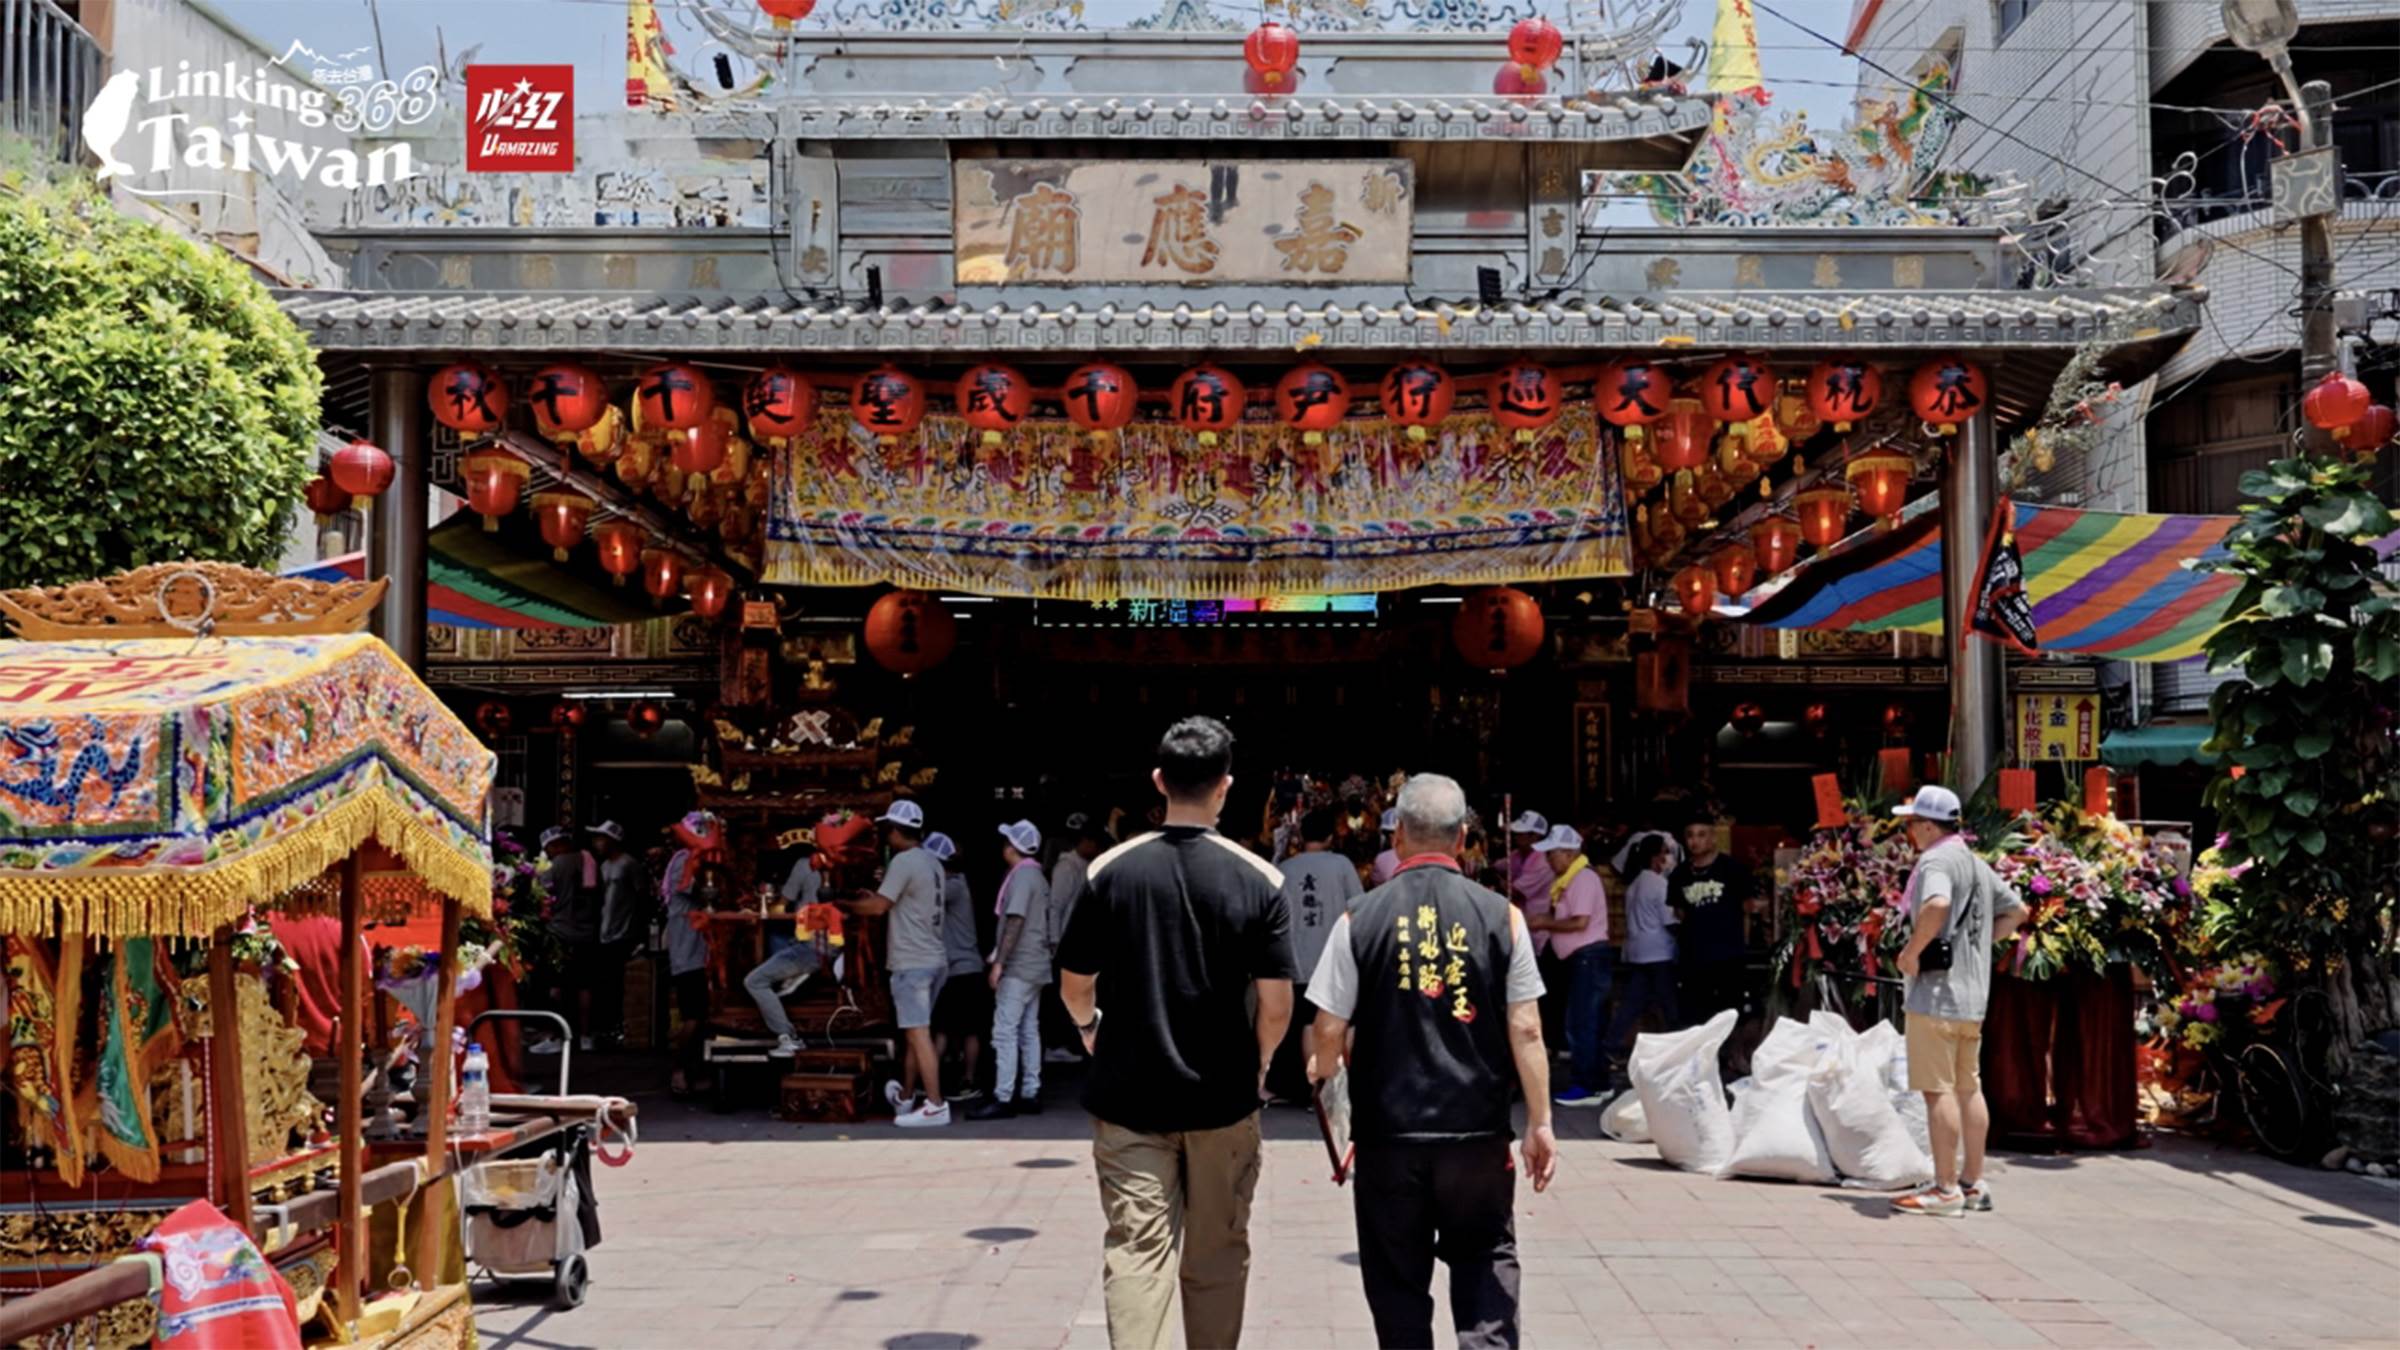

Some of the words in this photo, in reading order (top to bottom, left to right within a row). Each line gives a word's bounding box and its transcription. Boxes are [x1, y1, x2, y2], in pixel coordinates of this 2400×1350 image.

[1004, 179, 1360, 275] 嘉應廟
[1444, 921, 1472, 1018] 迎客王
